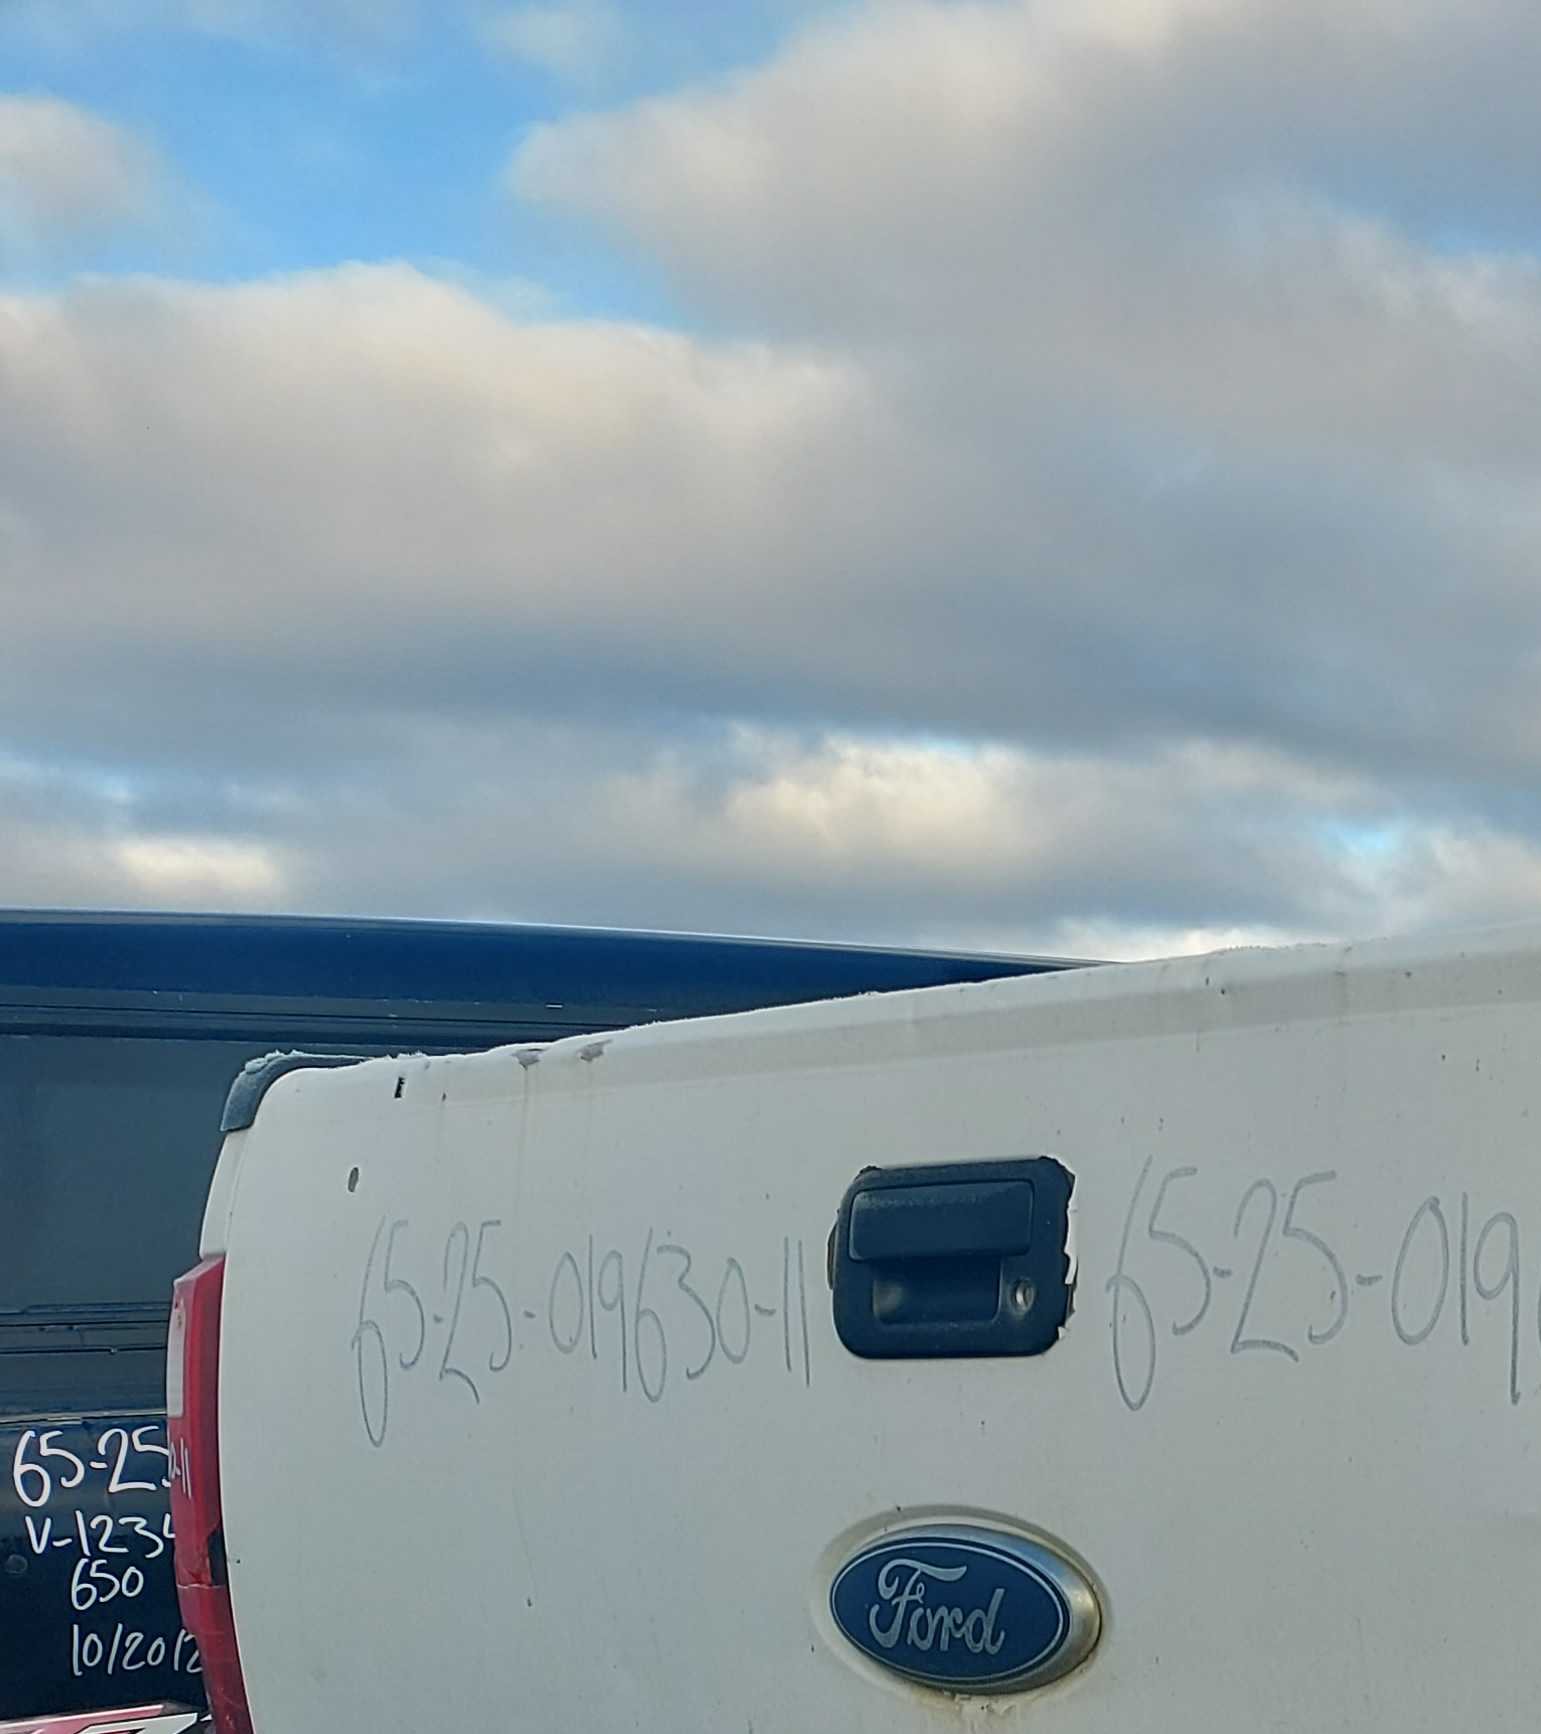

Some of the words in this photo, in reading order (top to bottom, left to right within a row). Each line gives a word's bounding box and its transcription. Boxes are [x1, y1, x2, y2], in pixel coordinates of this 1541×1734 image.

[351, 1214, 811, 1448] 65-25-019630-11
[71, 1558, 145, 1612] 650
[868, 1558, 1006, 1656] Ford
